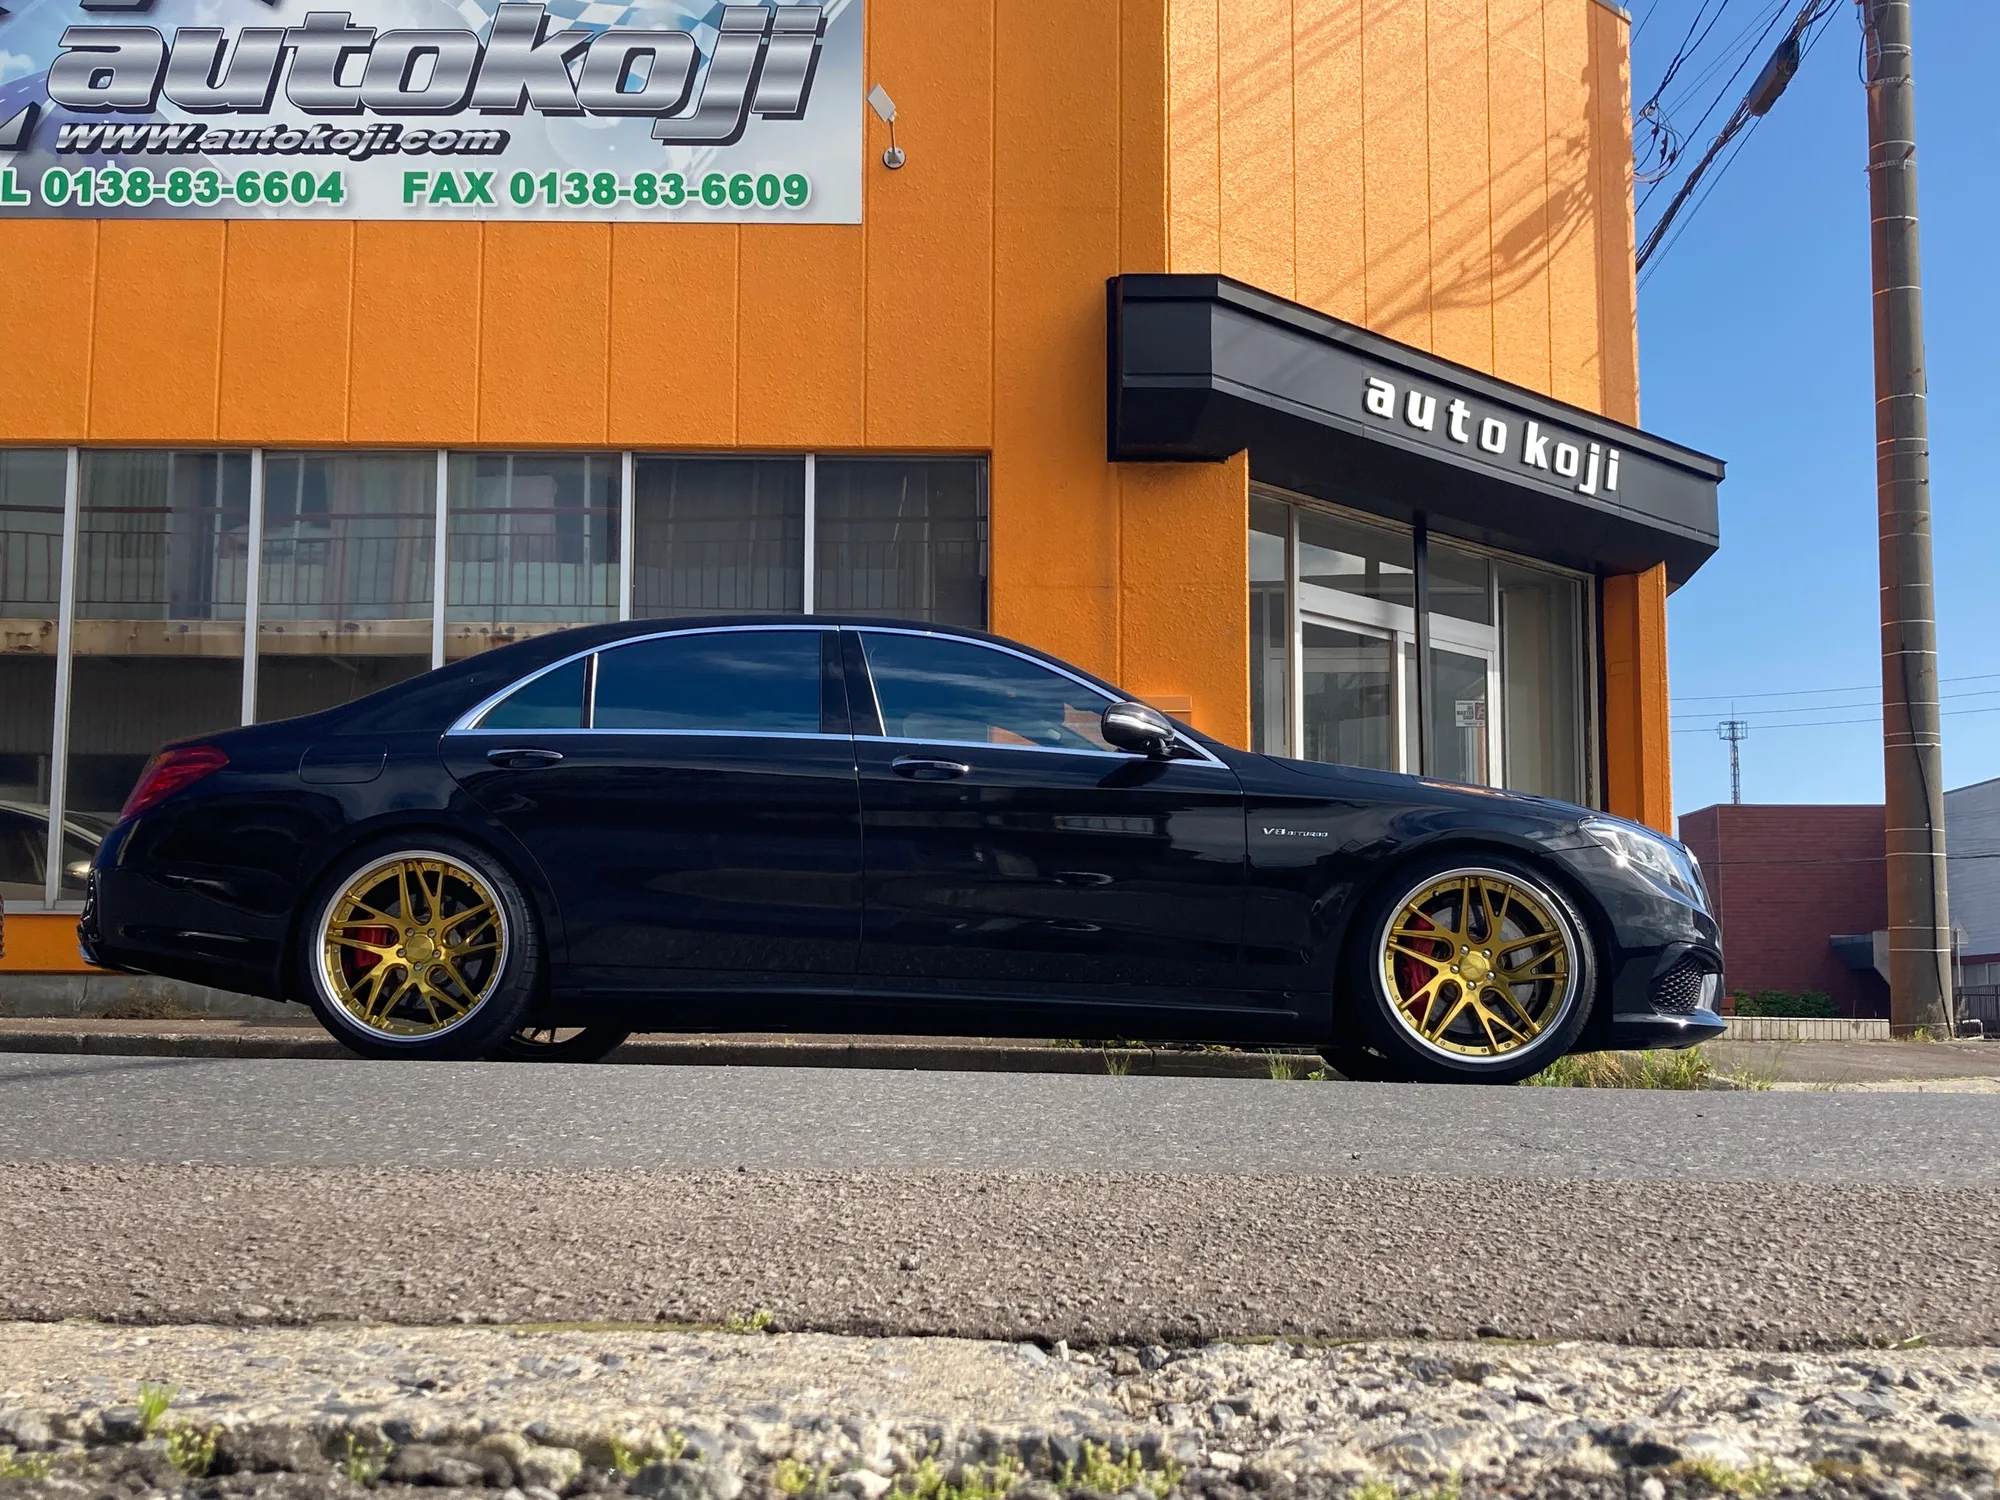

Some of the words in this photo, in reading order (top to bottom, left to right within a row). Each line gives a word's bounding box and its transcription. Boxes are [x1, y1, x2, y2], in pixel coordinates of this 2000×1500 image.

[47, 2, 827, 146] autokoji
[55, 124, 509, 160] www.autokoji.com
[44, 170, 345, 205] 0138-83-6604
[403, 172, 495, 205] FAX
[509, 172, 808, 207] 0138-83-6609
[1365, 376, 1507, 454] auto
[1523, 420, 1620, 495] koji
[1262, 827, 1286, 836] V8
